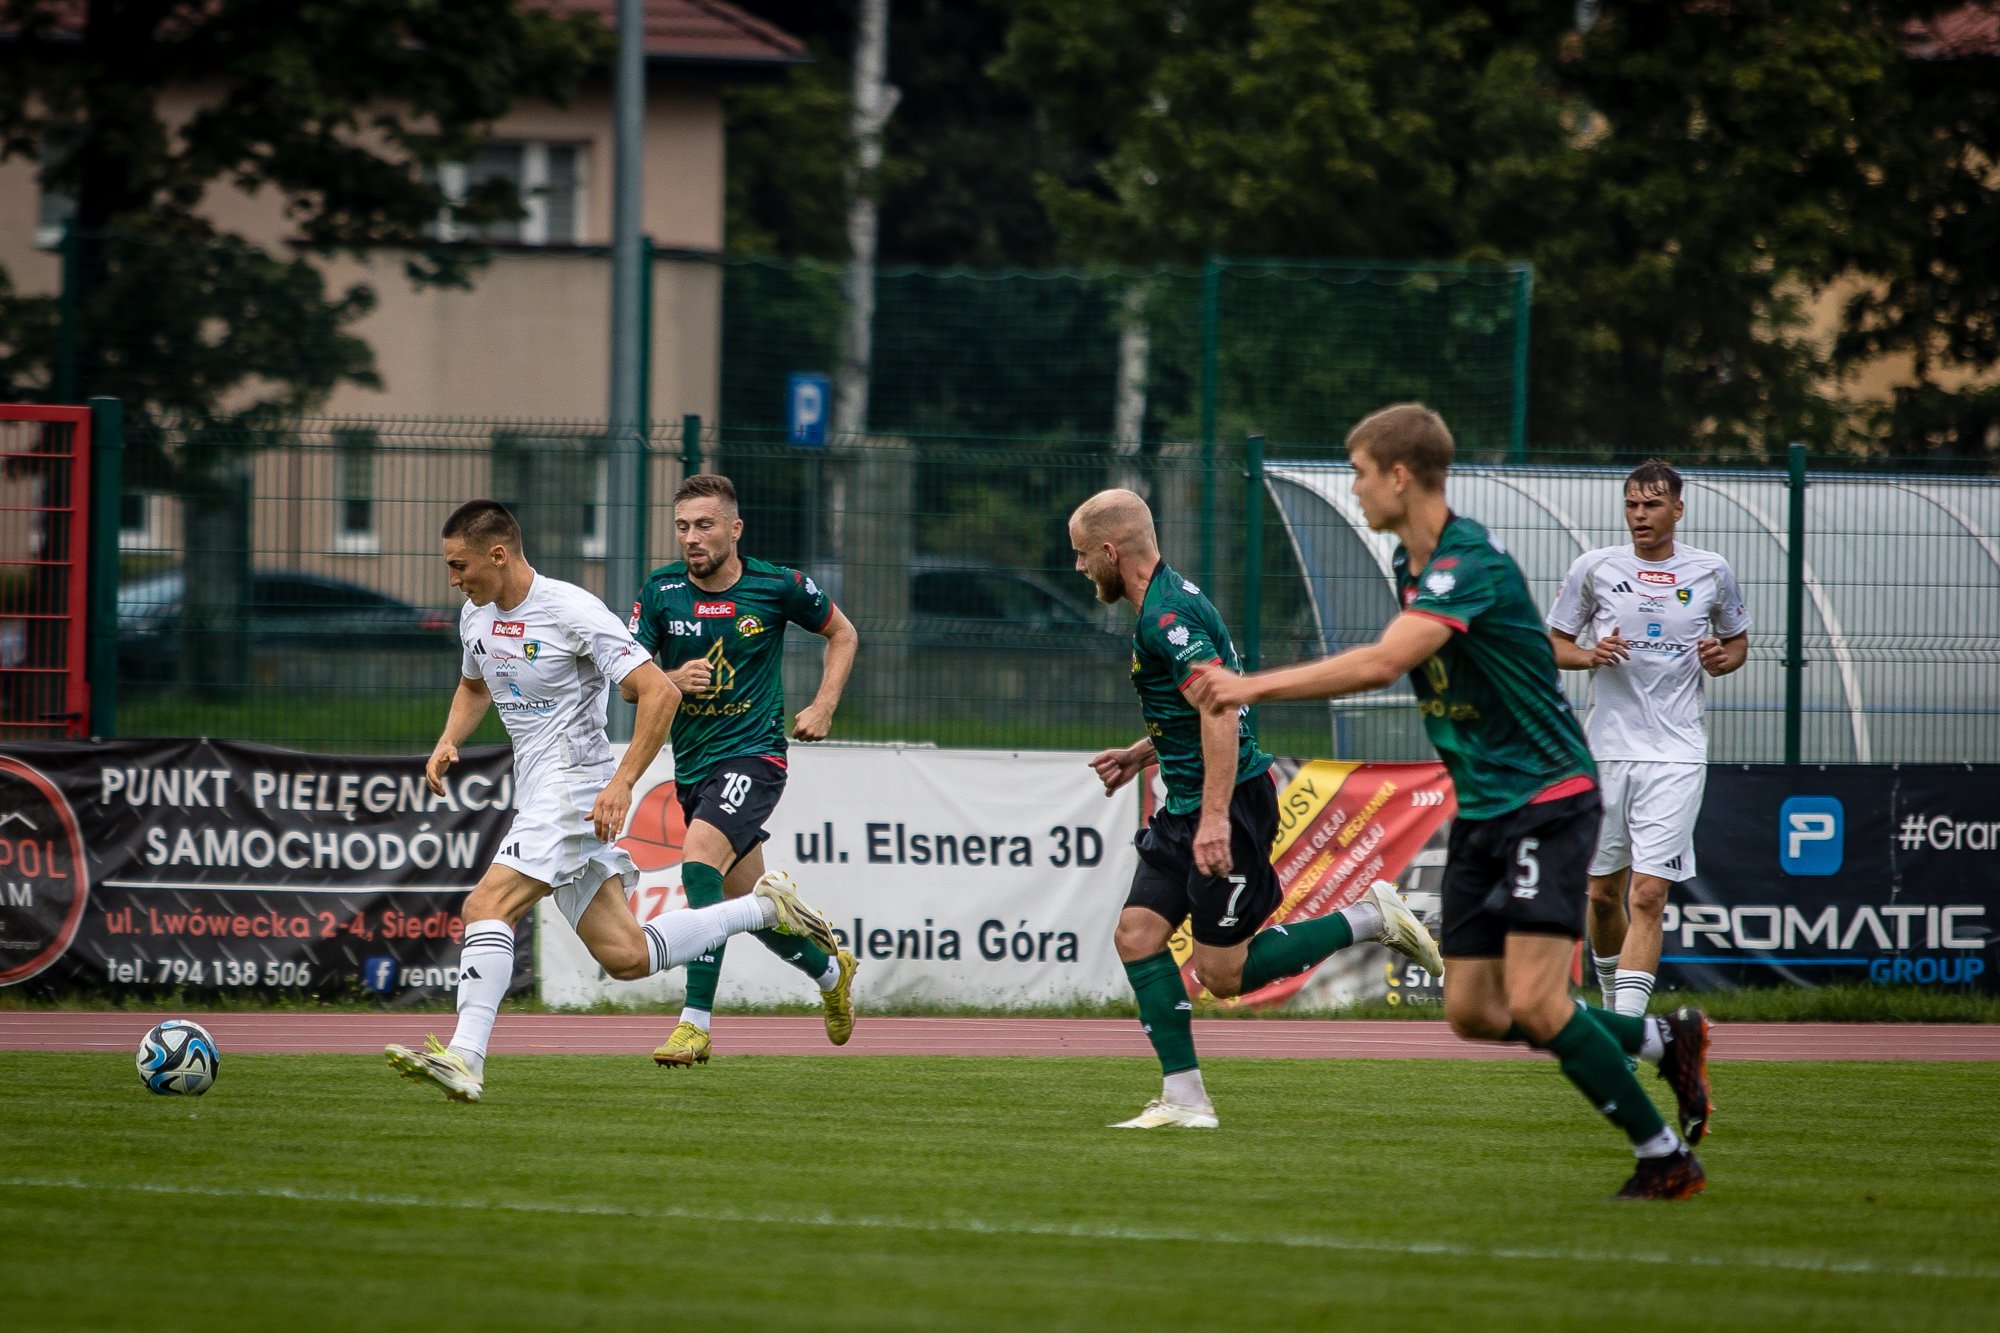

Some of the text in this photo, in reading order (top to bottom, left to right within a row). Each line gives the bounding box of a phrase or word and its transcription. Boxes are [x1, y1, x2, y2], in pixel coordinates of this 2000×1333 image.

[795, 384, 822, 439] P
[698, 604, 732, 615] Betclic
[1175, 640, 1204, 661] KATOWICE
[1627, 640, 1689, 653] ROMATIC
[102, 769, 518, 821] PUNKT PIELĘGNACJ
[720, 772, 752, 807] 18
[1337, 779, 1398, 849] MECHANIKA
[1788, 813, 1836, 859] P
[145, 822, 481, 871] SAMOCHODÓW
[795, 822, 1103, 868] ul. Elsnera 3D
[1280, 845, 1317, 887] MIANA
[1311, 808, 1347, 849] OLEJU
[1517, 837, 1540, 889] 5
[1305, 822, 1386, 914] WYMIANA OLEJU
[1227, 875, 1247, 916] 7
[105, 907, 465, 944] ul. Lwówecka 2-4, Siedlę
[831, 918, 1080, 963] elenia Góra
[107, 957, 311, 987] tel. 794 138 506
[376, 961, 460, 991] f renp
[1869, 955, 1985, 984] GROUP
